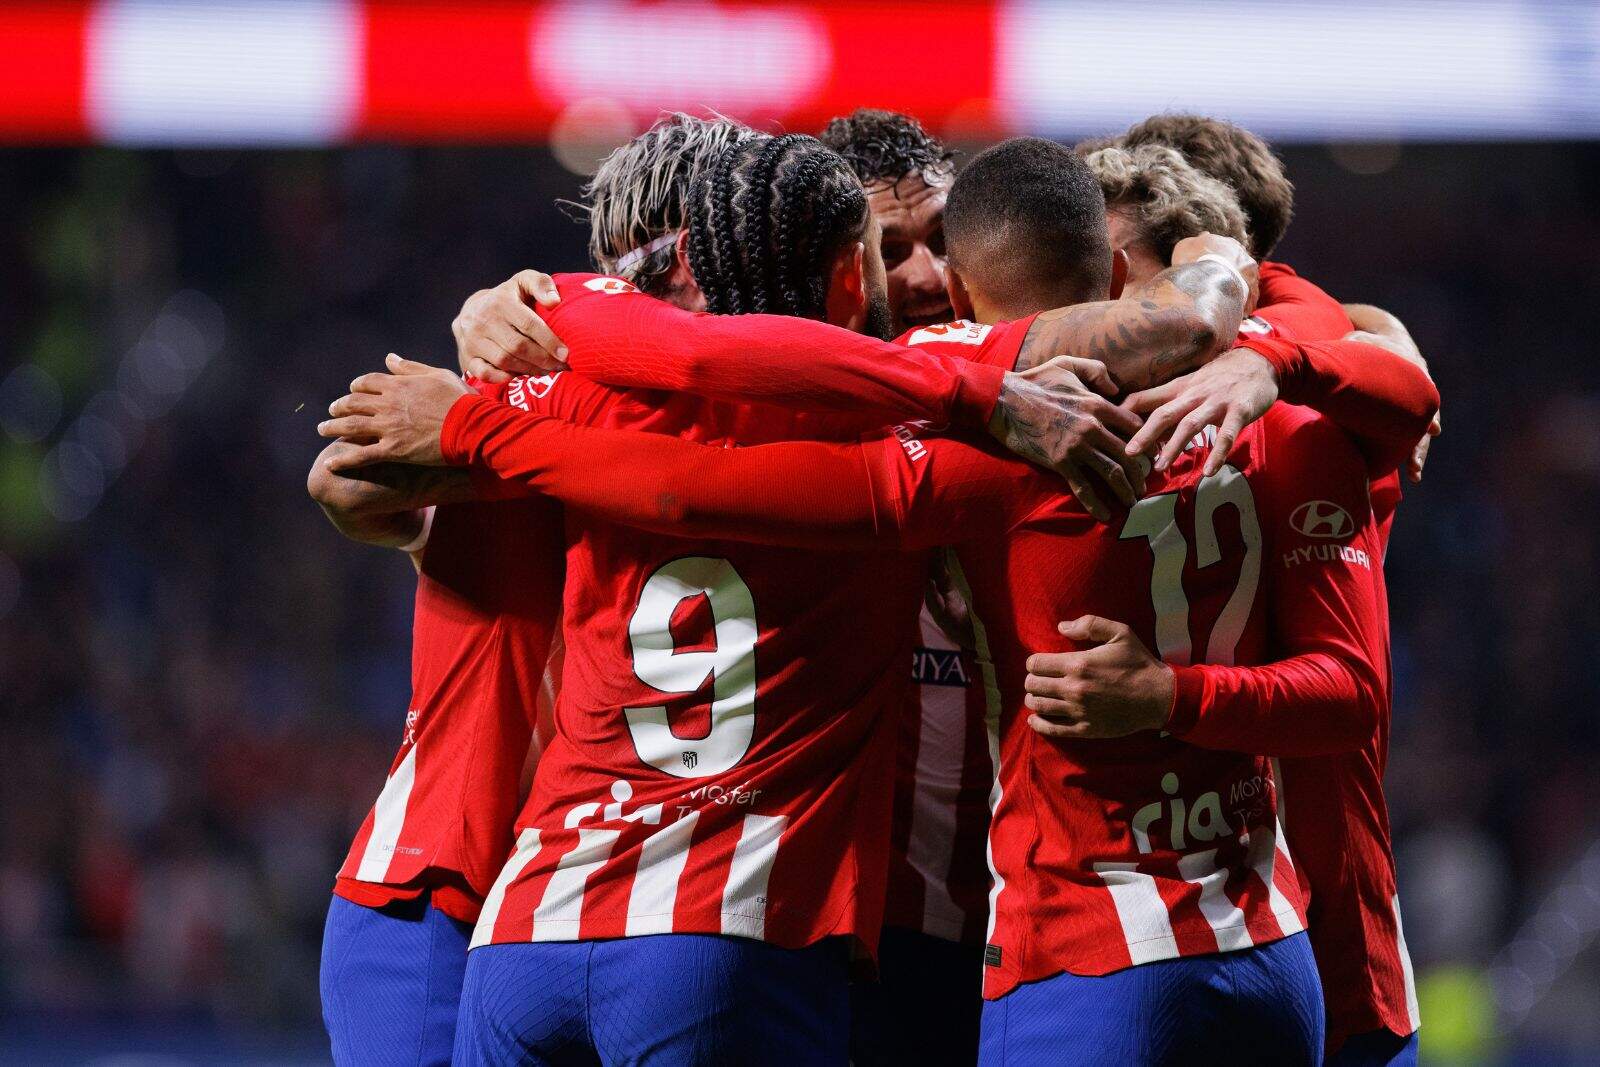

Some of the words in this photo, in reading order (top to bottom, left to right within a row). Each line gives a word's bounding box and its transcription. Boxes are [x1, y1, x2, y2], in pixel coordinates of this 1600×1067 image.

[1119, 466, 1263, 666] 12
[1282, 543, 1371, 571] HYUNDAI
[627, 555, 758, 779] 9
[1131, 772, 1234, 855] ria
